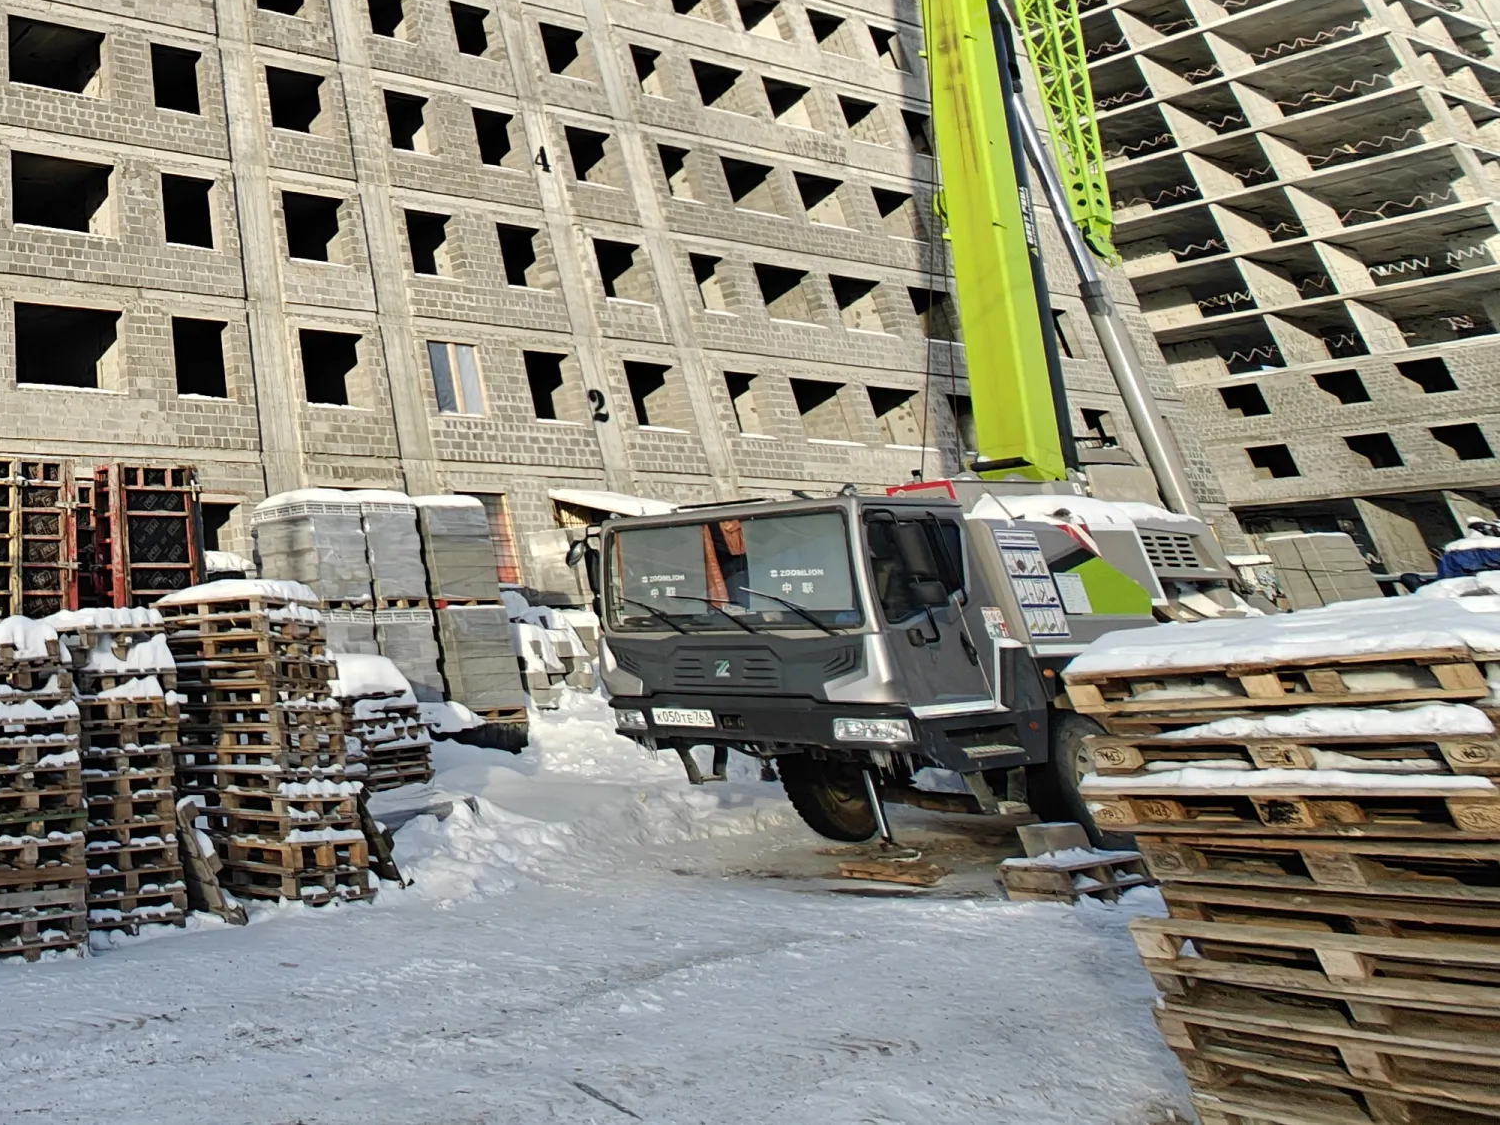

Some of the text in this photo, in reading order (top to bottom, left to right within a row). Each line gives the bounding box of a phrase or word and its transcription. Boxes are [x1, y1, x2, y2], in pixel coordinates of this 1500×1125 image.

[534, 146, 552, 173] 4
[587, 389, 610, 423] 2
[648, 574, 685, 582] ZOOMLION
[780, 569, 824, 577] ZOOMLION
